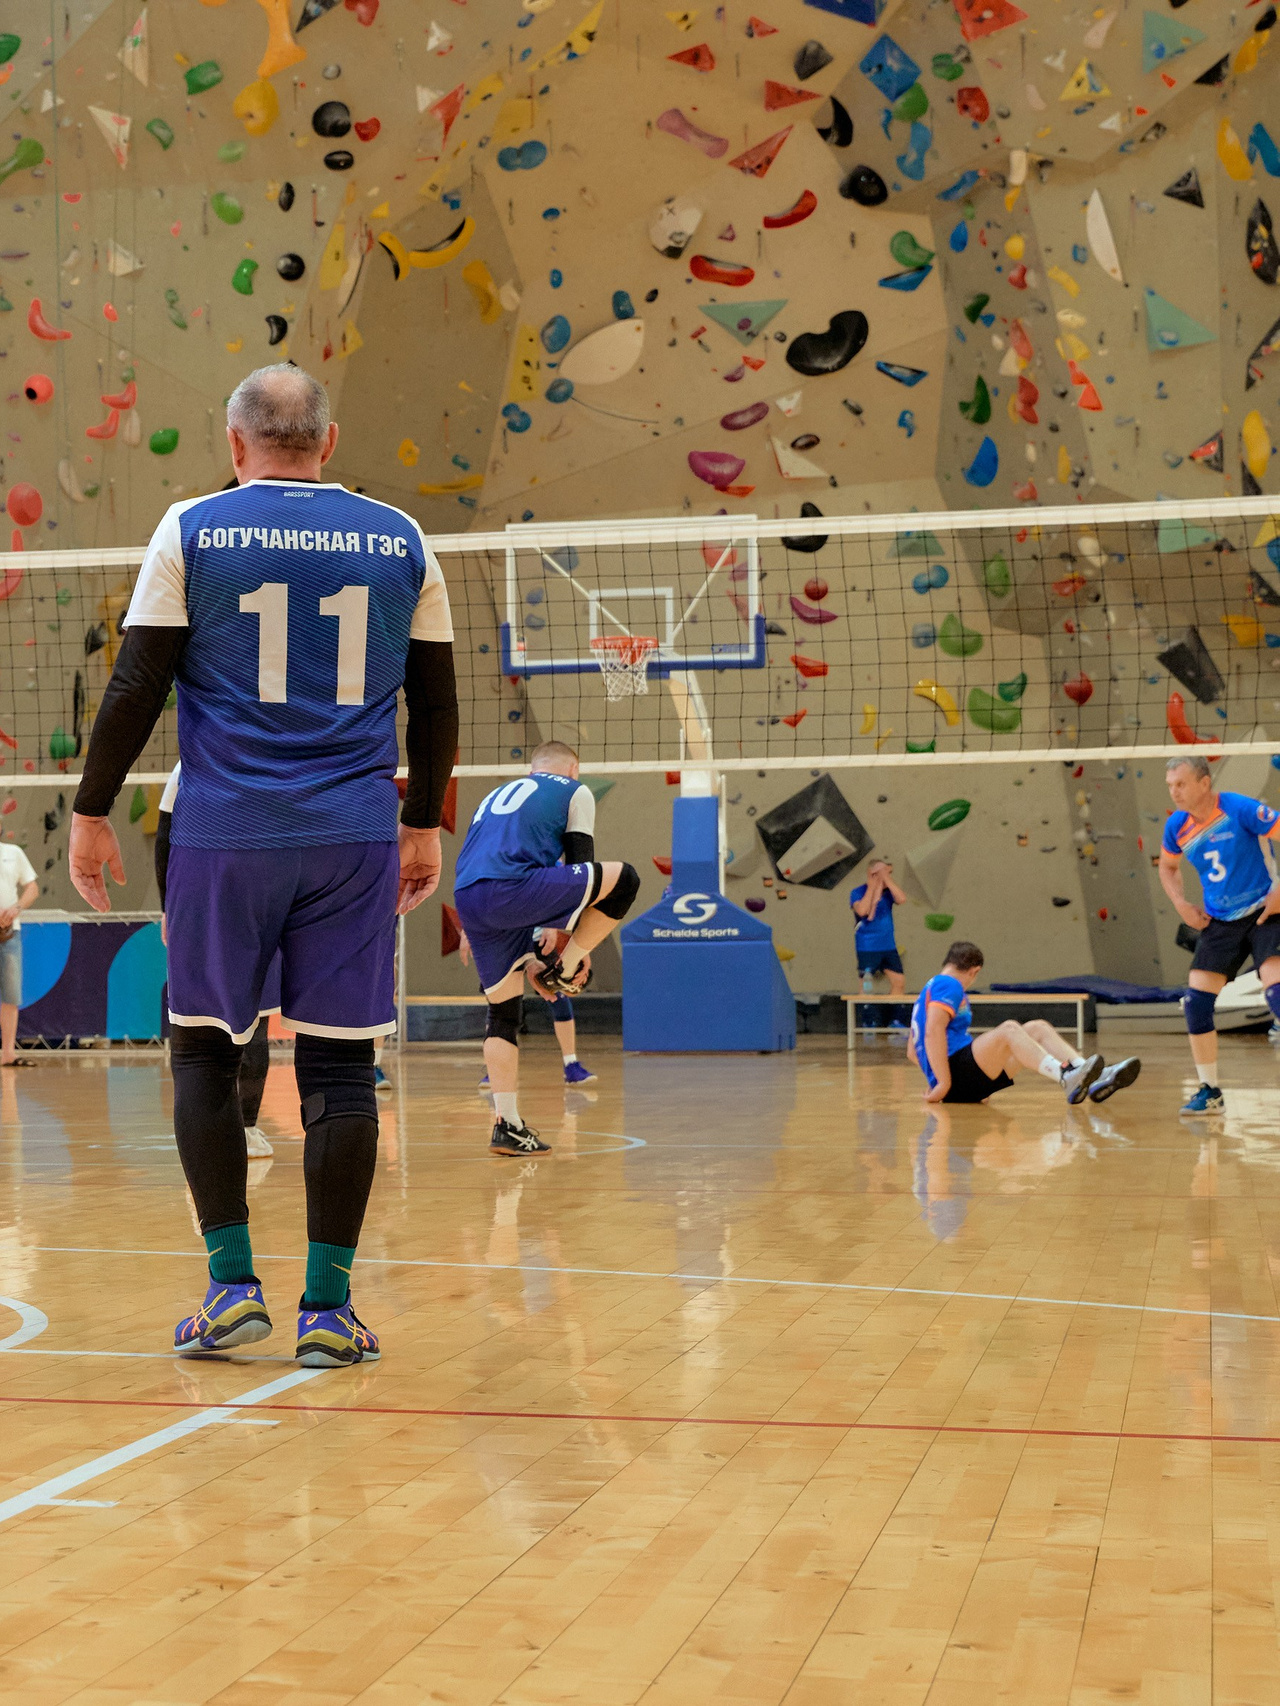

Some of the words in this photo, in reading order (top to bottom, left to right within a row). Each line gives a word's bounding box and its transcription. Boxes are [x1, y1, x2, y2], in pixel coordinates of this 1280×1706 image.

[198, 527, 360, 553] БОГУЧАНСКАЯ
[367, 533, 408, 558] ГЭС
[239, 582, 369, 705] 11
[472, 778, 539, 825] 10
[1203, 850, 1227, 883] 3
[652, 928, 700, 938] Schelde
[700, 927, 739, 939] Sports
